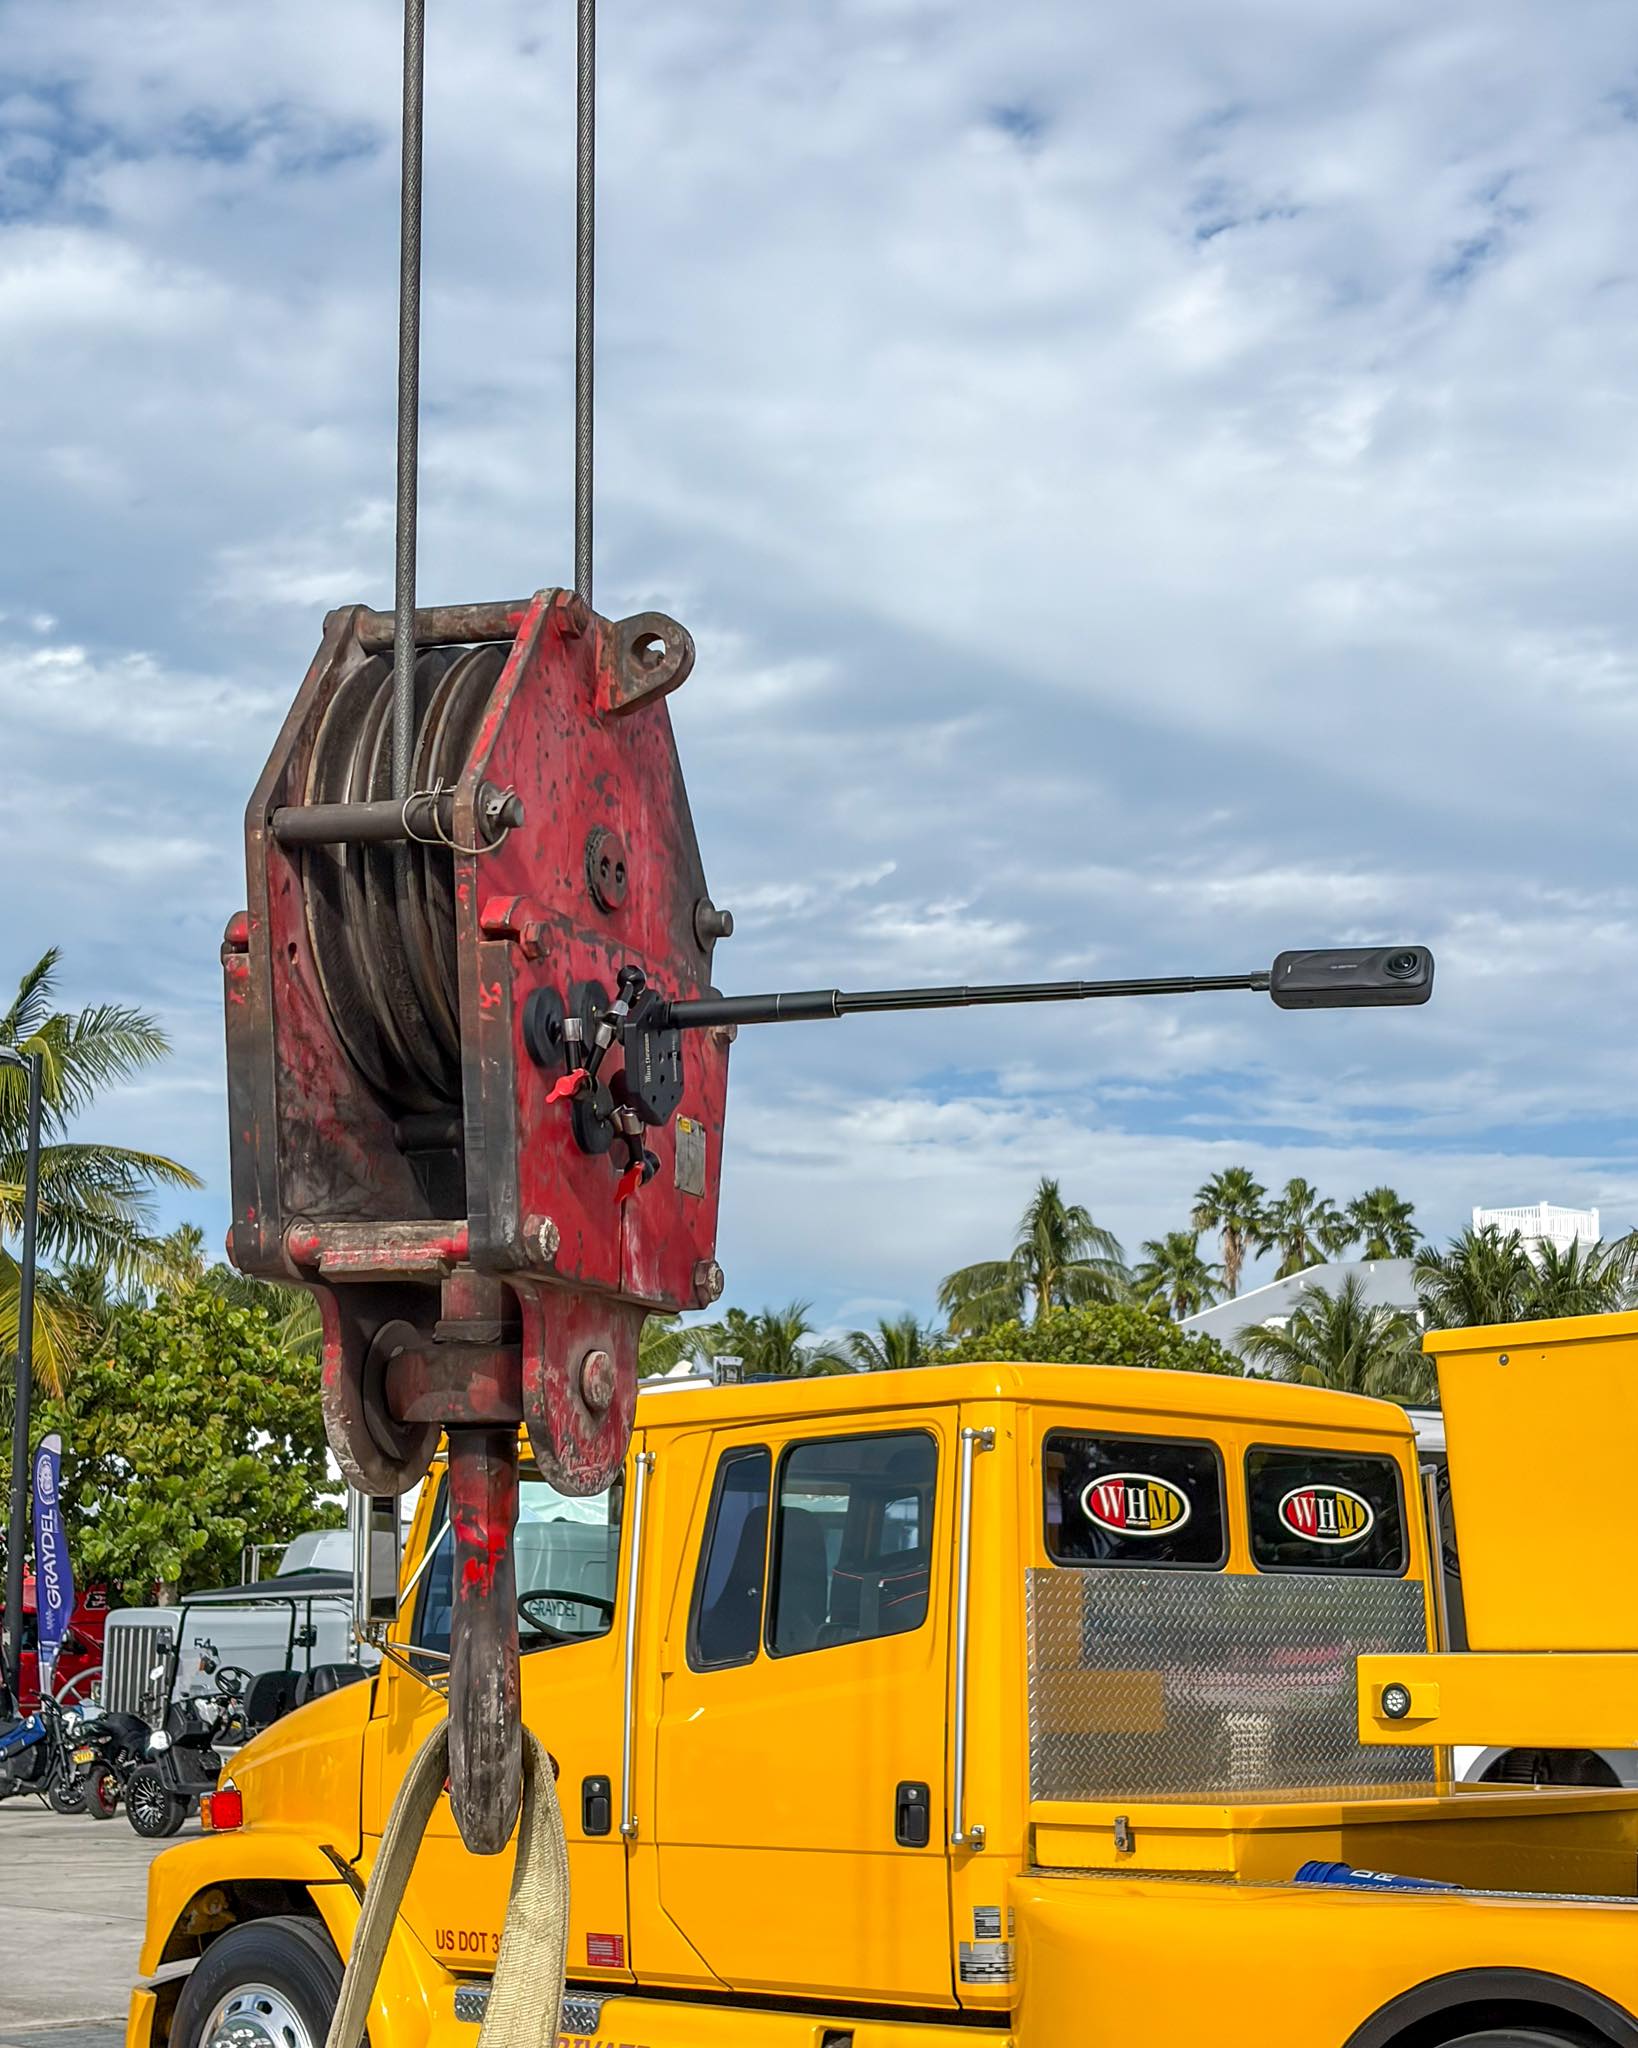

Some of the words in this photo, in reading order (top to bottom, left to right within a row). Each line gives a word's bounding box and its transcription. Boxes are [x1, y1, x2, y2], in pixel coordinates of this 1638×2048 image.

[1096, 1485, 1171, 1521] WHM
[1291, 1496, 1358, 1529] WHM
[41, 1508, 62, 1609] GRAYDEL
[528, 1600, 576, 1617] GRAYDEL
[436, 1929, 455, 1950] US
[459, 1931, 488, 1952] DOT
[491, 1933, 502, 1953] 3
